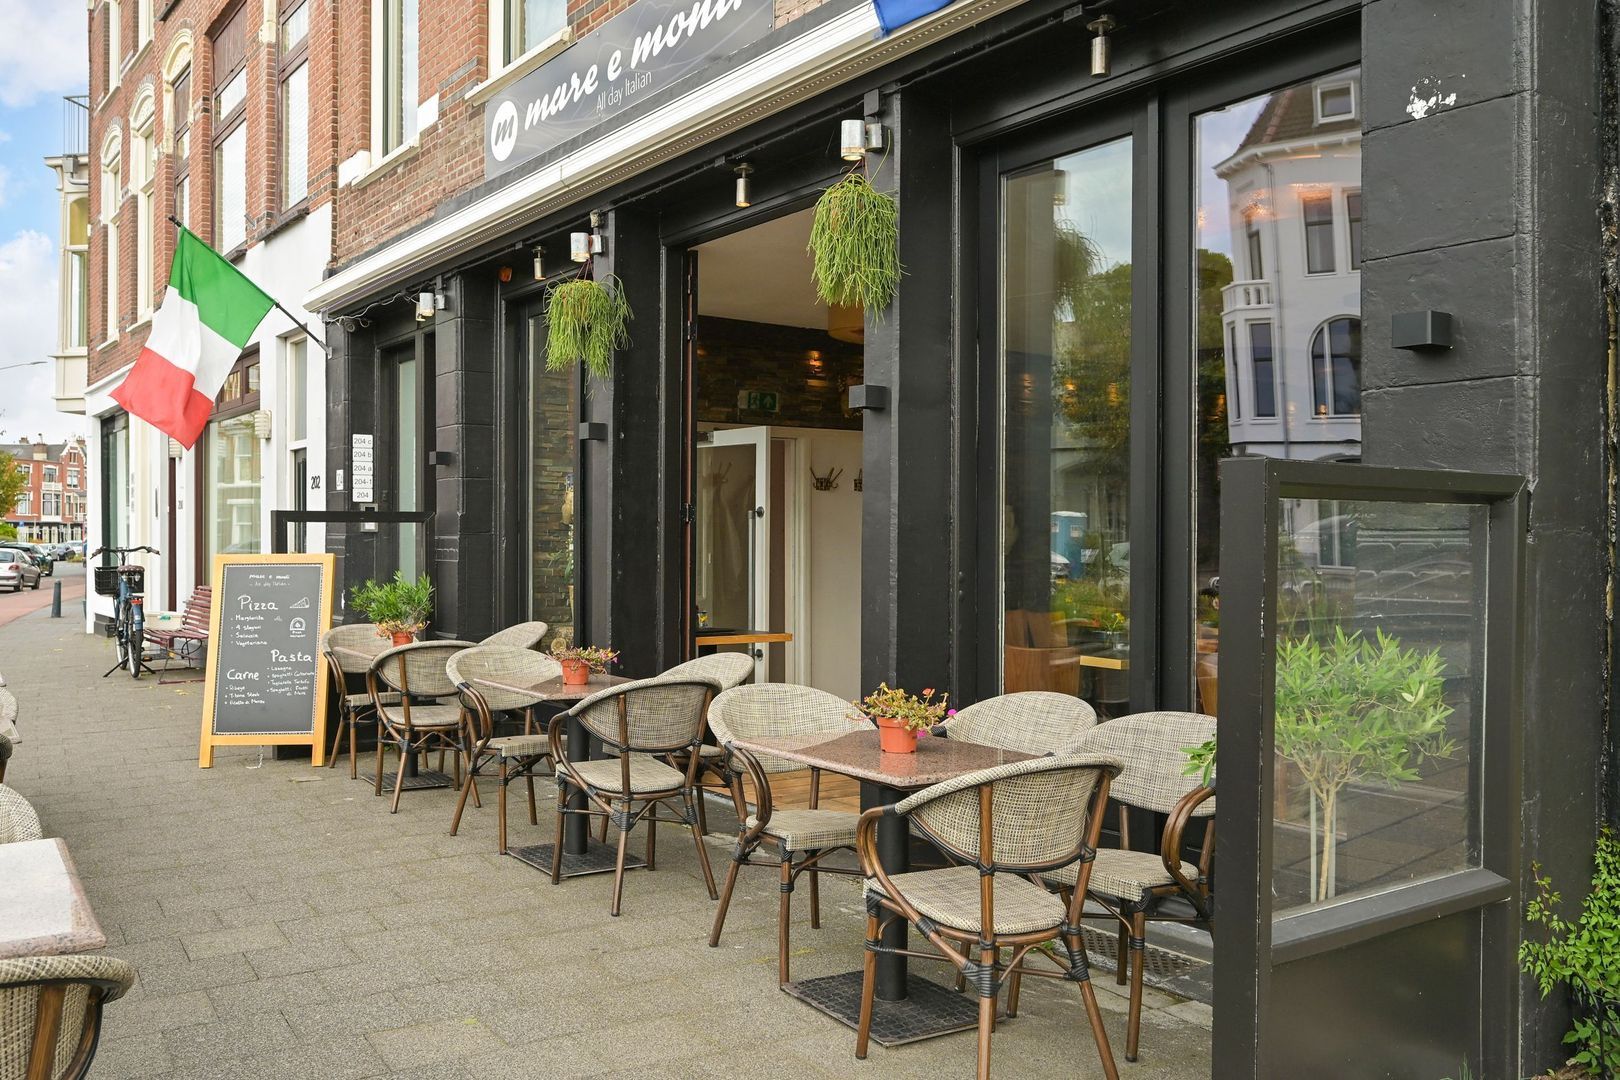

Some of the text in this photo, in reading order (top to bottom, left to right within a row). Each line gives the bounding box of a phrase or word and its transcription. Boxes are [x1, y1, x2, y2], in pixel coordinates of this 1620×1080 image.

[525, 0, 742, 131] mare e mon
[596, 72, 652, 113] All day Italian
[311, 475, 320, 490] 202
[238, 594, 278, 611] Pizza
[270, 649, 312, 662] Pasta
[226, 668, 260, 680] Carne
